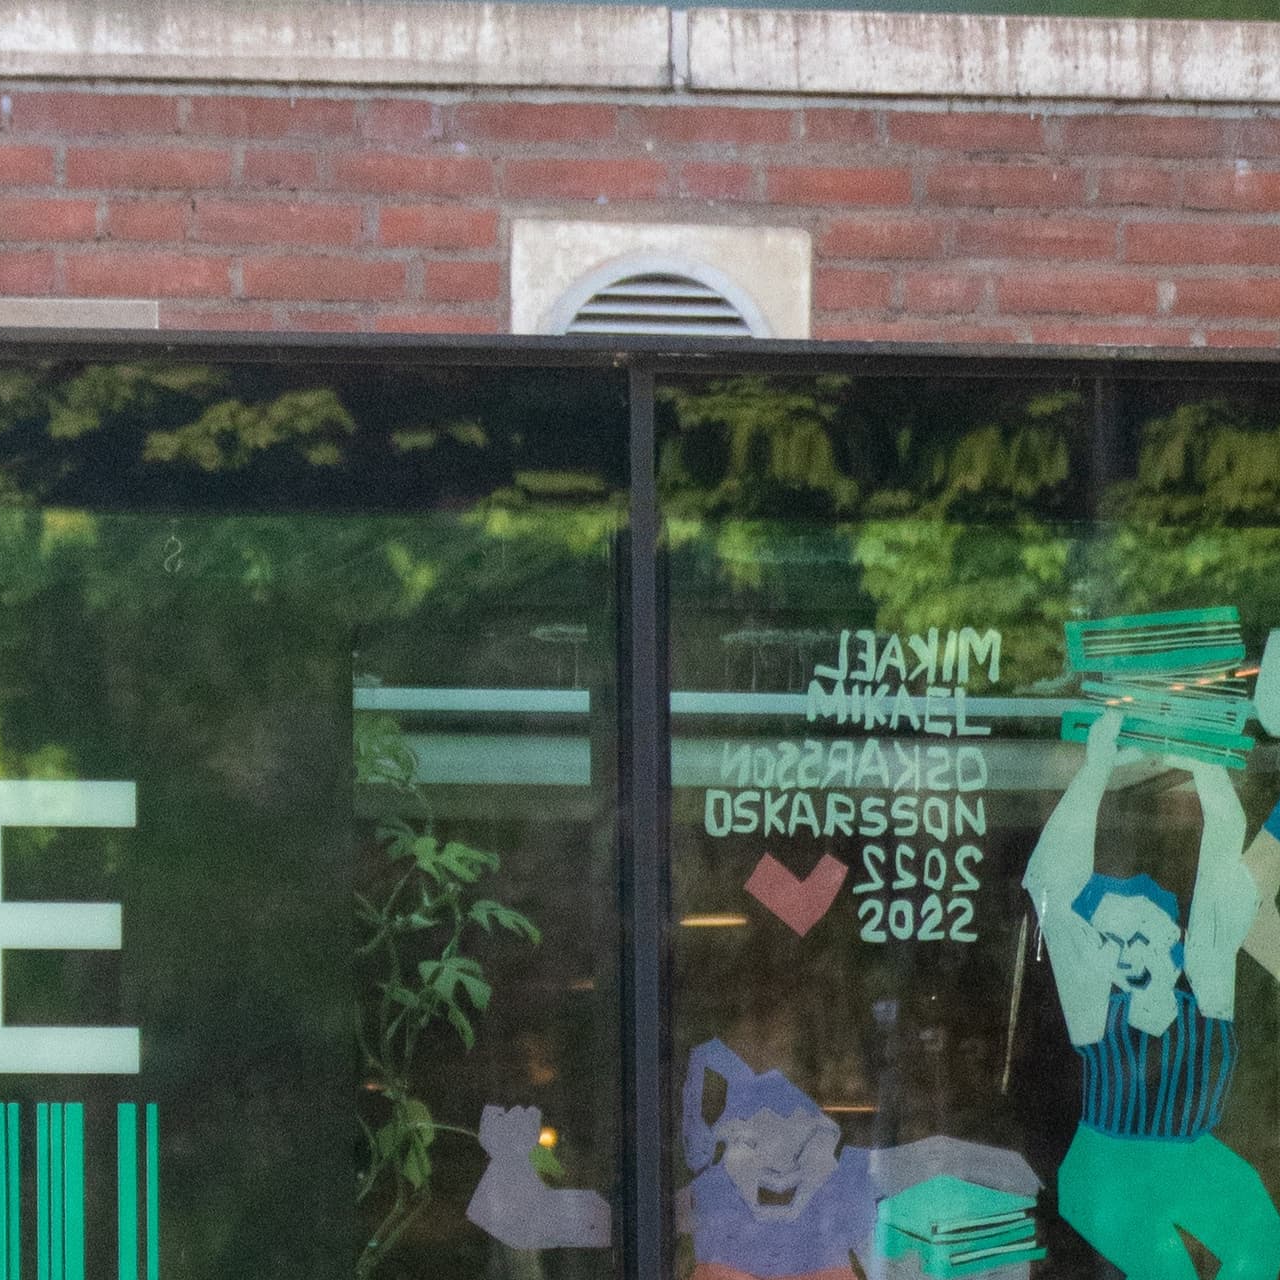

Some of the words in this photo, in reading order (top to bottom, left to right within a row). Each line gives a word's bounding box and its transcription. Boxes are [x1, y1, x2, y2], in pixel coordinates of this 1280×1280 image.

[807, 679, 991, 737] MIKAEL
[704, 788, 987, 842] OSKARSSON
[858, 894, 979, 943] 2022
